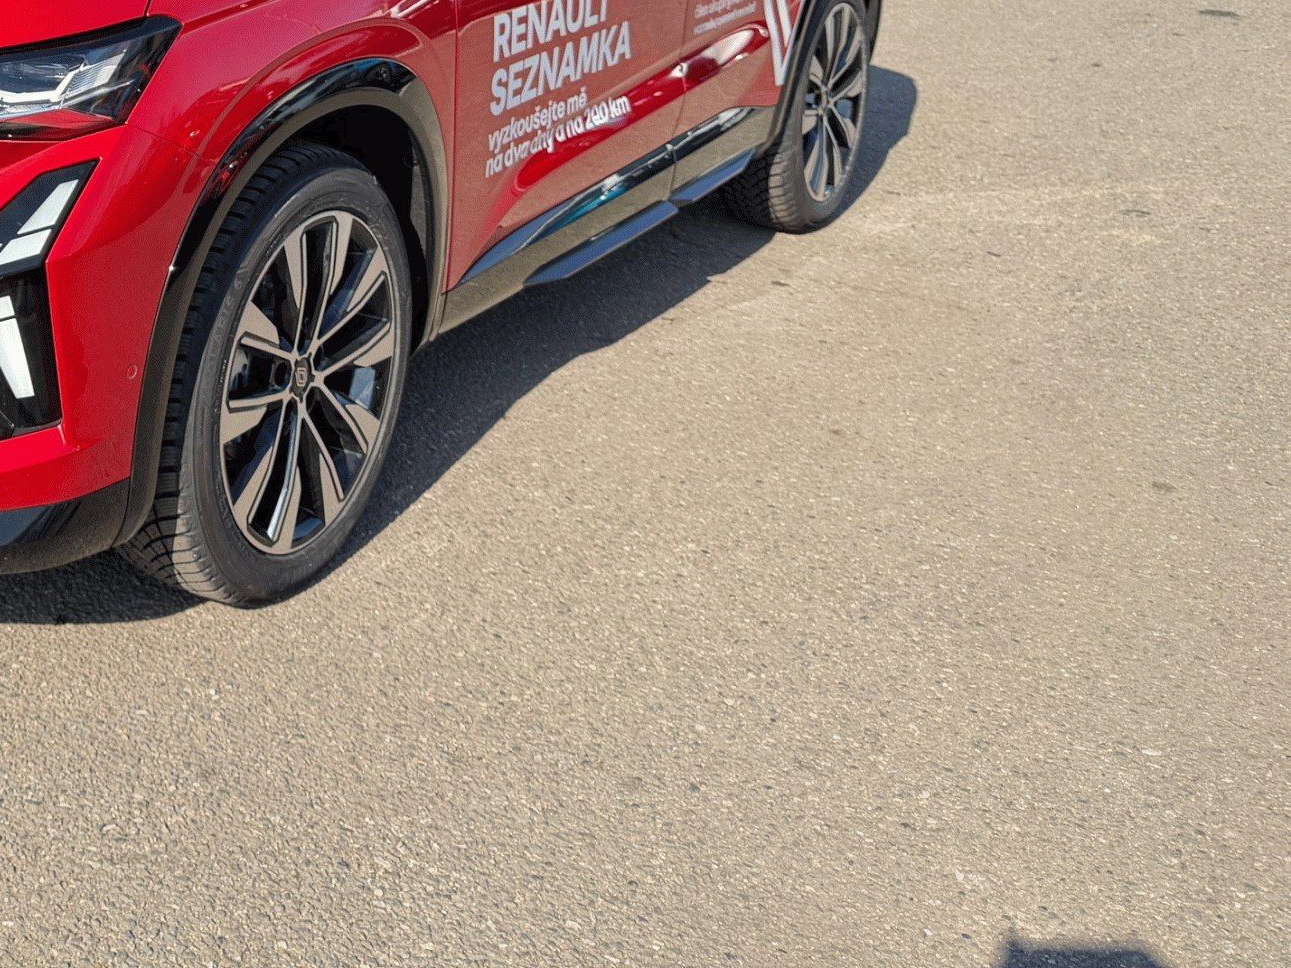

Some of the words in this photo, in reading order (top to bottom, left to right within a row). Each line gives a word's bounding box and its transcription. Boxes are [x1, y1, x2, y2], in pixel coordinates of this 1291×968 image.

[490, 20, 631, 116] SEZNAMKA
[485, 152, 503, 178] na
[504, 140, 530, 167] dva
[530, 129, 556, 153] dny
[555, 123, 567, 142] a
[567, 118, 585, 138] na
[608, 95, 632, 119] km
[488, 100, 565, 153] vyzkoušejte
[567, 86, 588, 115] mě
